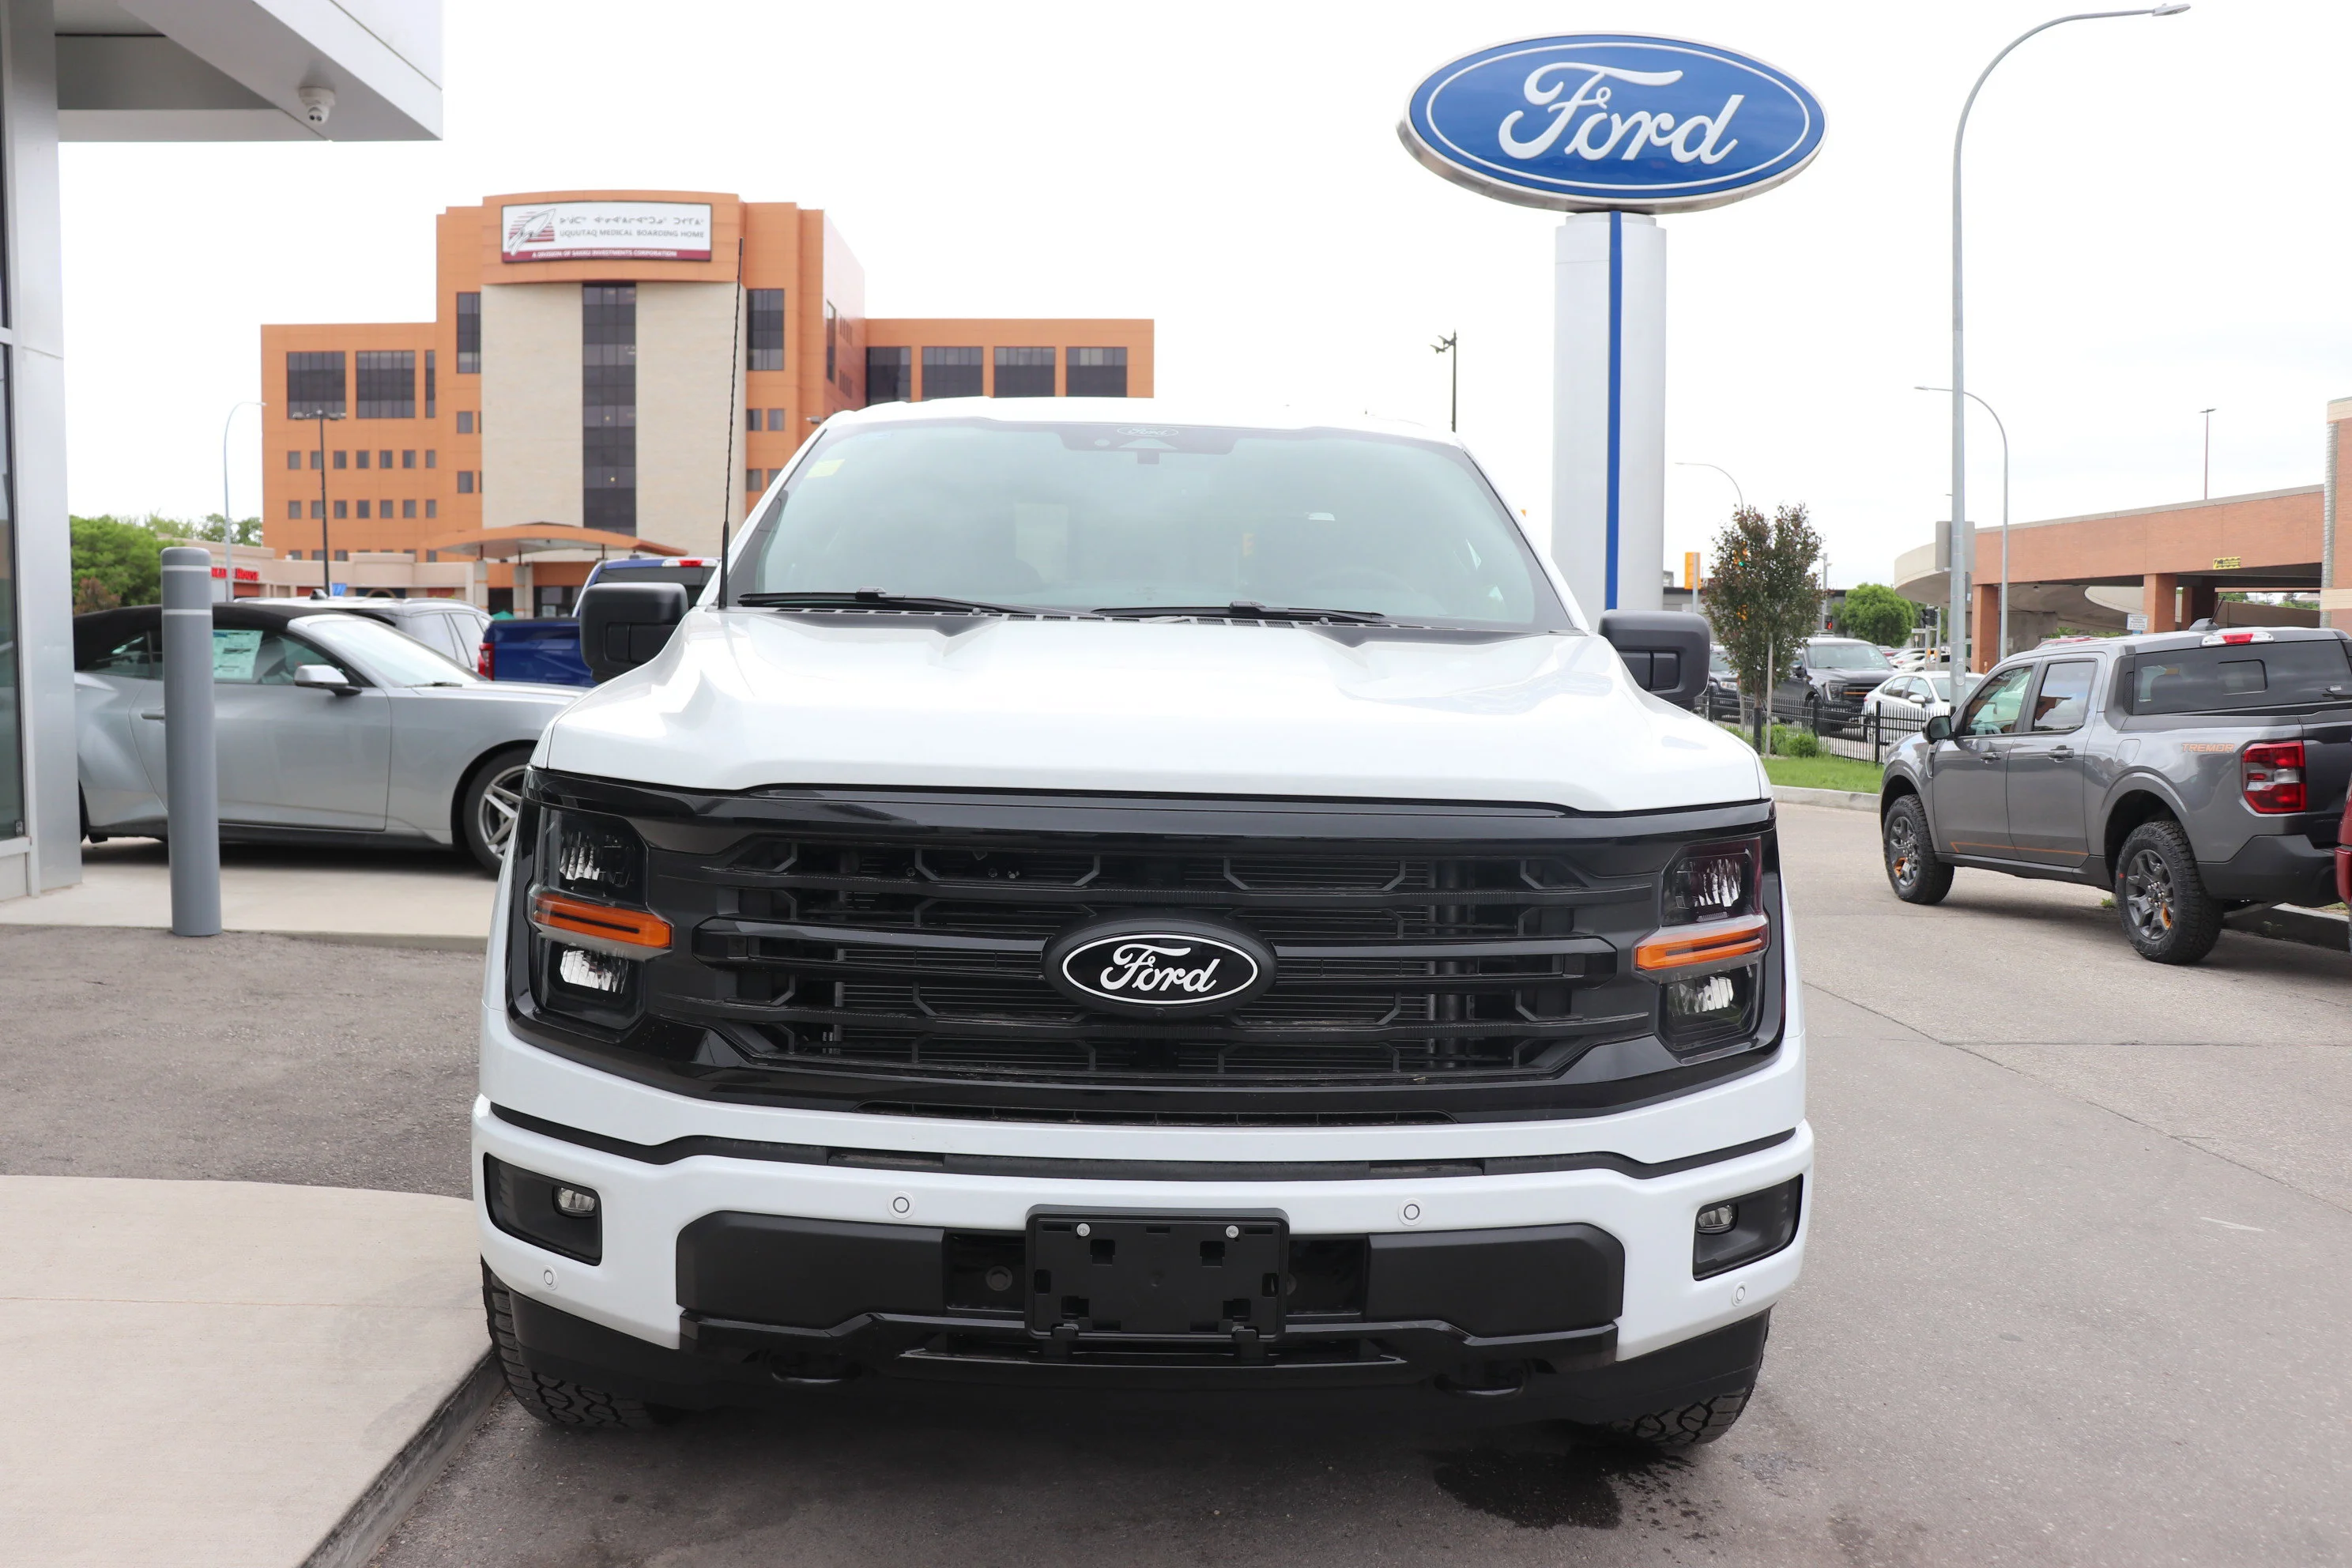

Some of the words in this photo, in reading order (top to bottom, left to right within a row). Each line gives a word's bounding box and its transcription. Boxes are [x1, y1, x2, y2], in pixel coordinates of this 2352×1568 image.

[1498, 62, 1744, 164] Ford
[2182, 743, 2235, 752] TREMOR
[1100, 944, 1220, 993] Ford
